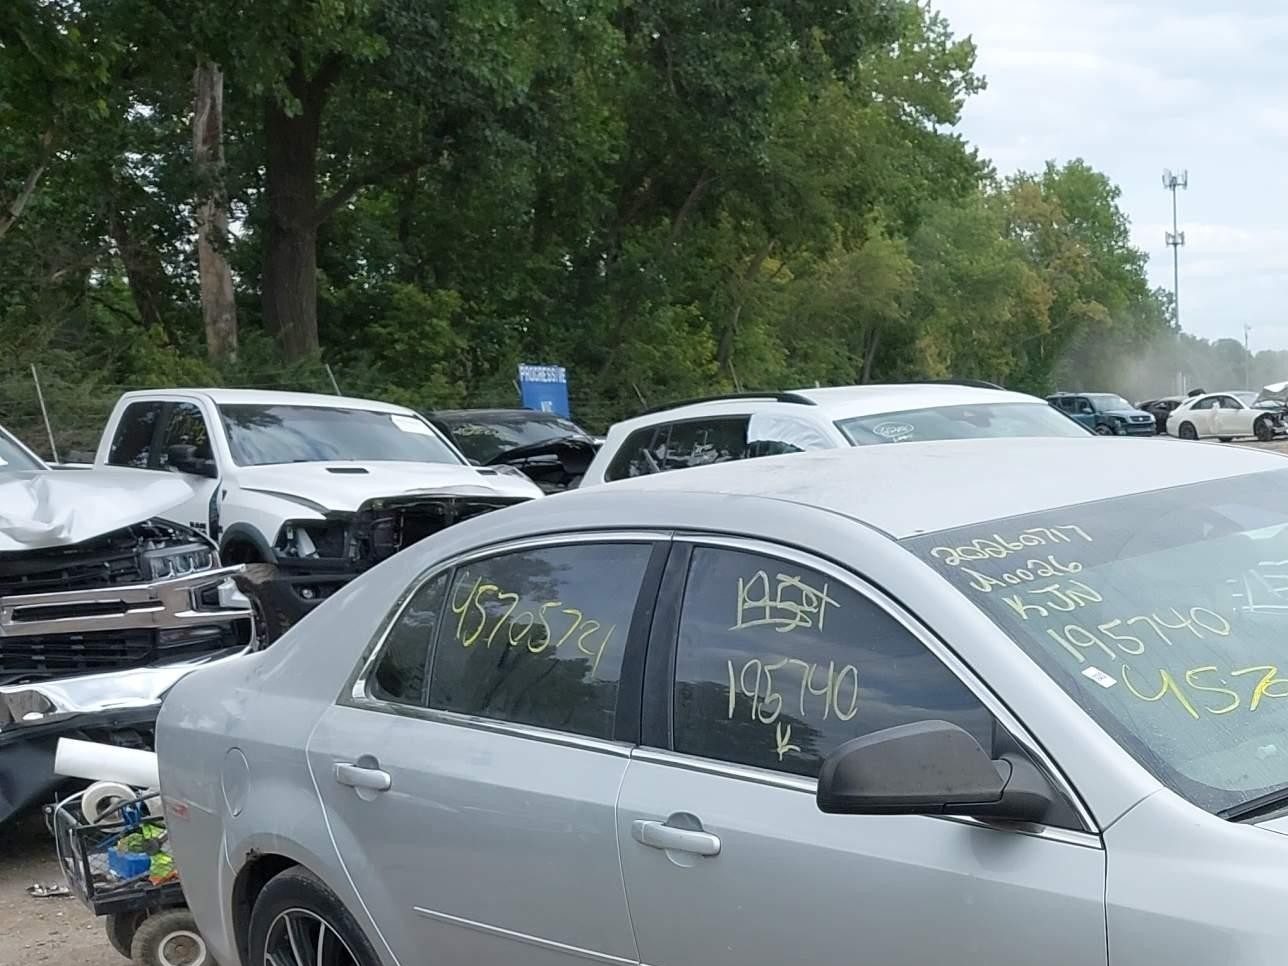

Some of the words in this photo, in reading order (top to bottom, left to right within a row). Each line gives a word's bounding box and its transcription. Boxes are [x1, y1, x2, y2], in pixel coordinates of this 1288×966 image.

[451, 572, 617, 679] 45705721
[1046, 606, 1232, 663] 195740
[727, 657, 859, 725] 195740
